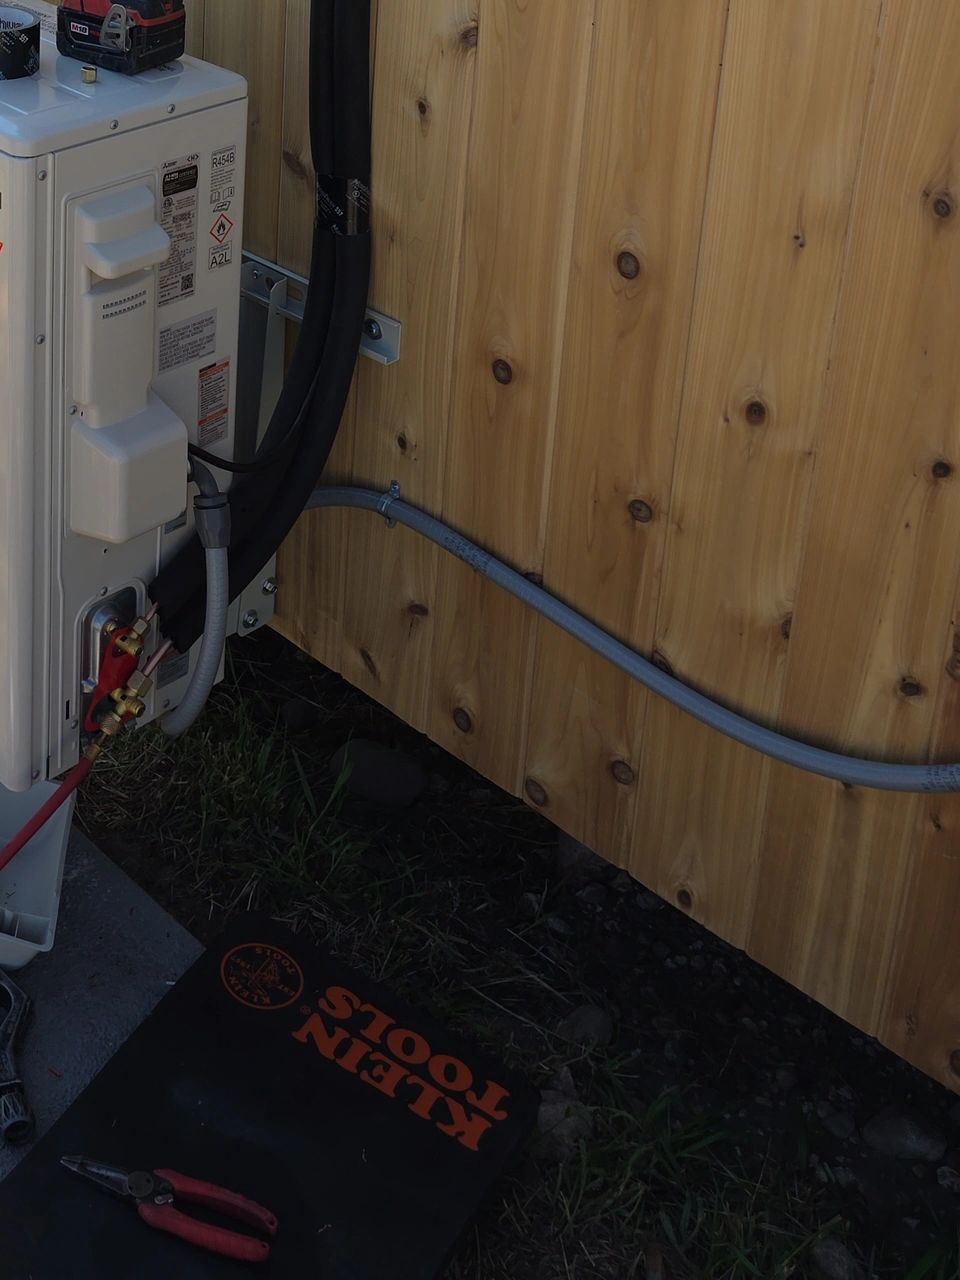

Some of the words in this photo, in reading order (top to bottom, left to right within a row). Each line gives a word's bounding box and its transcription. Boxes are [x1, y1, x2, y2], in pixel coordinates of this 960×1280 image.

[71, 23, 88, 34] M18
[212, 151, 235, 168] R454B
[211, 251, 230, 268] A2L
[318, 985, 510, 1121] TOOLS
[292, 1013, 492, 1152] KLEIN
